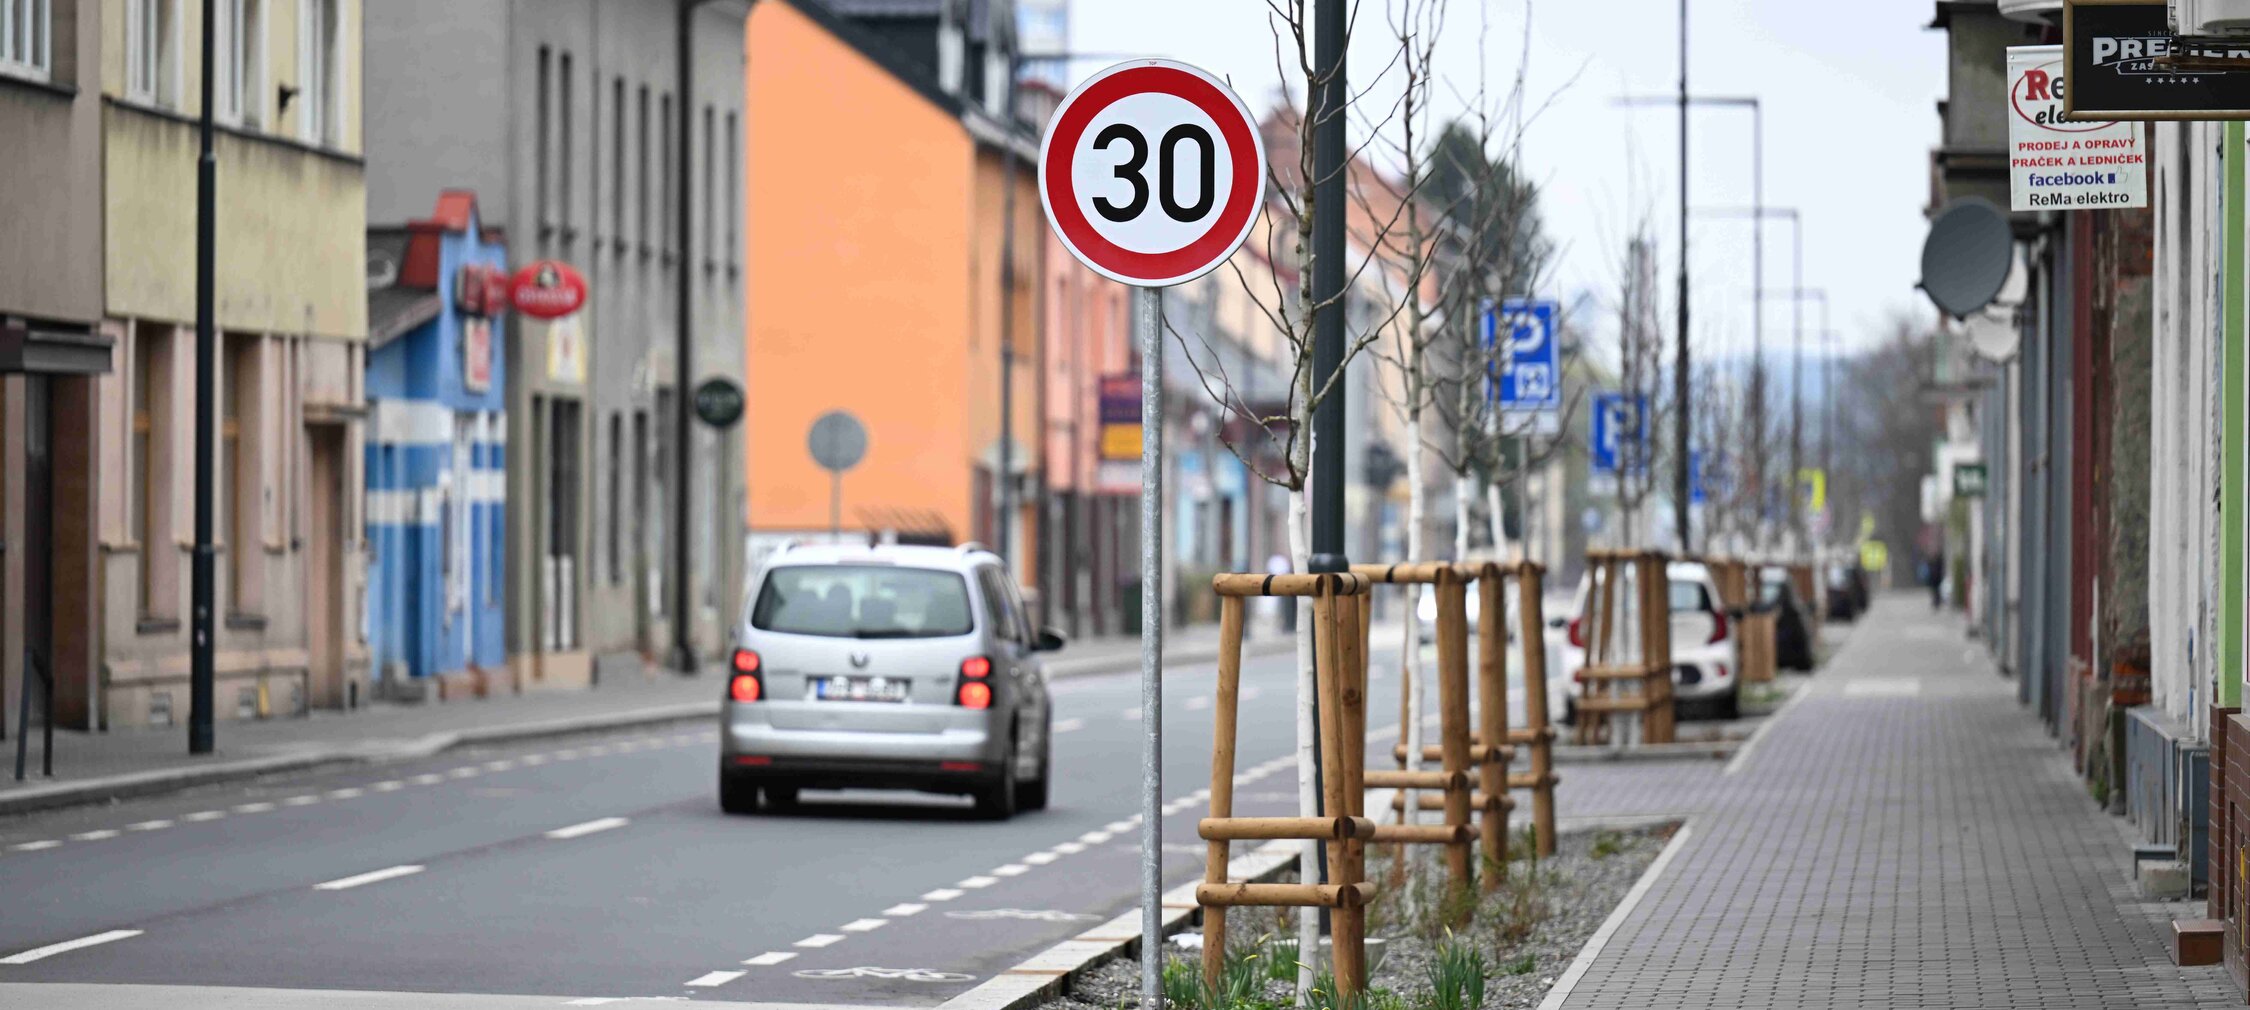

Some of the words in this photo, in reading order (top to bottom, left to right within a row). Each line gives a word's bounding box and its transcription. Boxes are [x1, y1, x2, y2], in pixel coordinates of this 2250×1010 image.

[2131, 63, 2153, 71] ZAS
[2025, 70, 2063, 100] Re
[2019, 141, 2068, 151] PRODEJ
[2072, 140, 2081, 150] A
[2012, 157, 2063, 168] PRAČEK
[2067, 157, 2076, 166] A
[2080, 153, 2143, 165] LEDNIČEK
[1092, 123, 1215, 223] 30
[2029, 171, 2104, 187] facebook
[2030, 193, 2072, 206] ReMa
[2077, 191, 2130, 205] elektro
[1500, 310, 1545, 377] P
